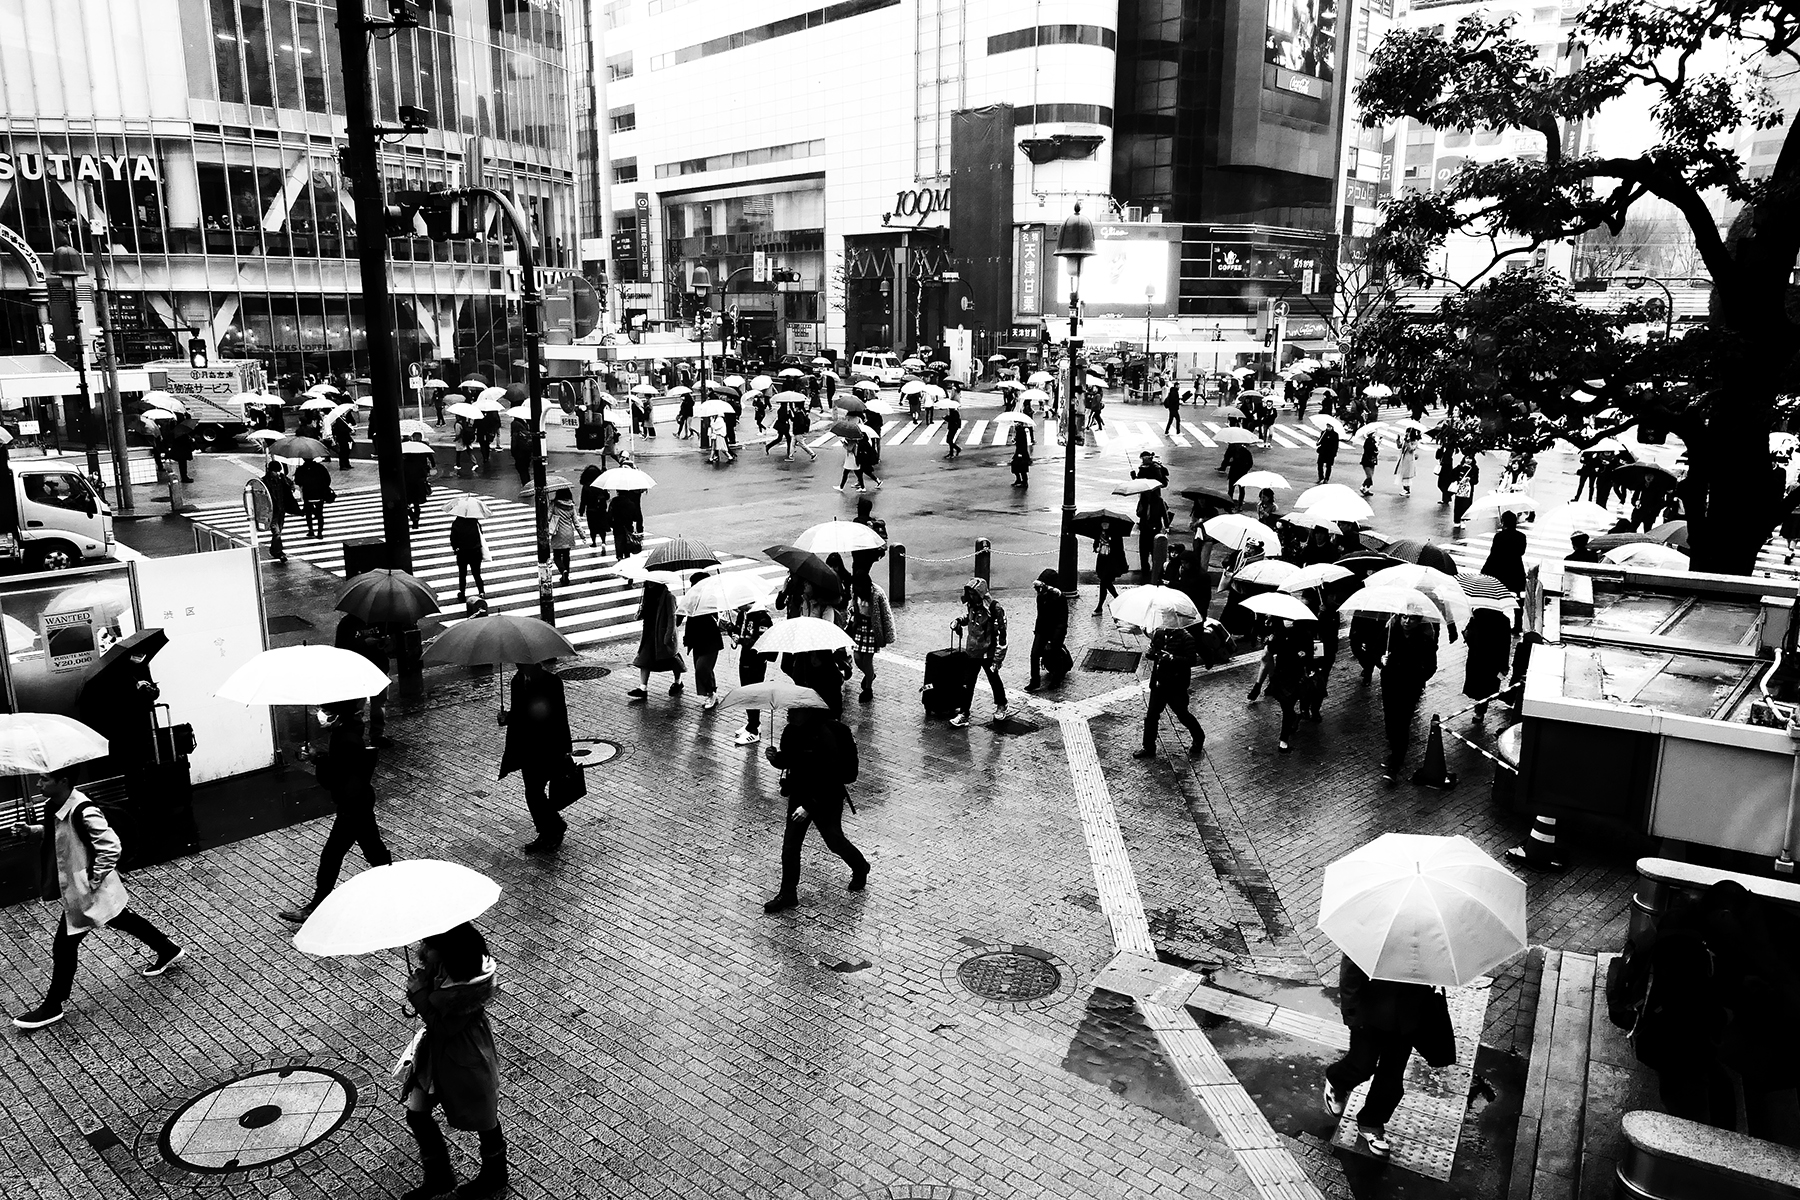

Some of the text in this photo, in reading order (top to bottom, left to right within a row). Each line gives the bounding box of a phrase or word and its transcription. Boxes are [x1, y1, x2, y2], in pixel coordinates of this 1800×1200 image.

[1382, 155, 1392, 181] アコム
[1347, 185, 1366, 201] アコム
[1101, 227, 1128, 239] Glico
[1023, 243, 1036, 311] 天津甘栗
[45, 612, 91, 625] WANTED
[54, 656, 93, 667] ¥20,000
